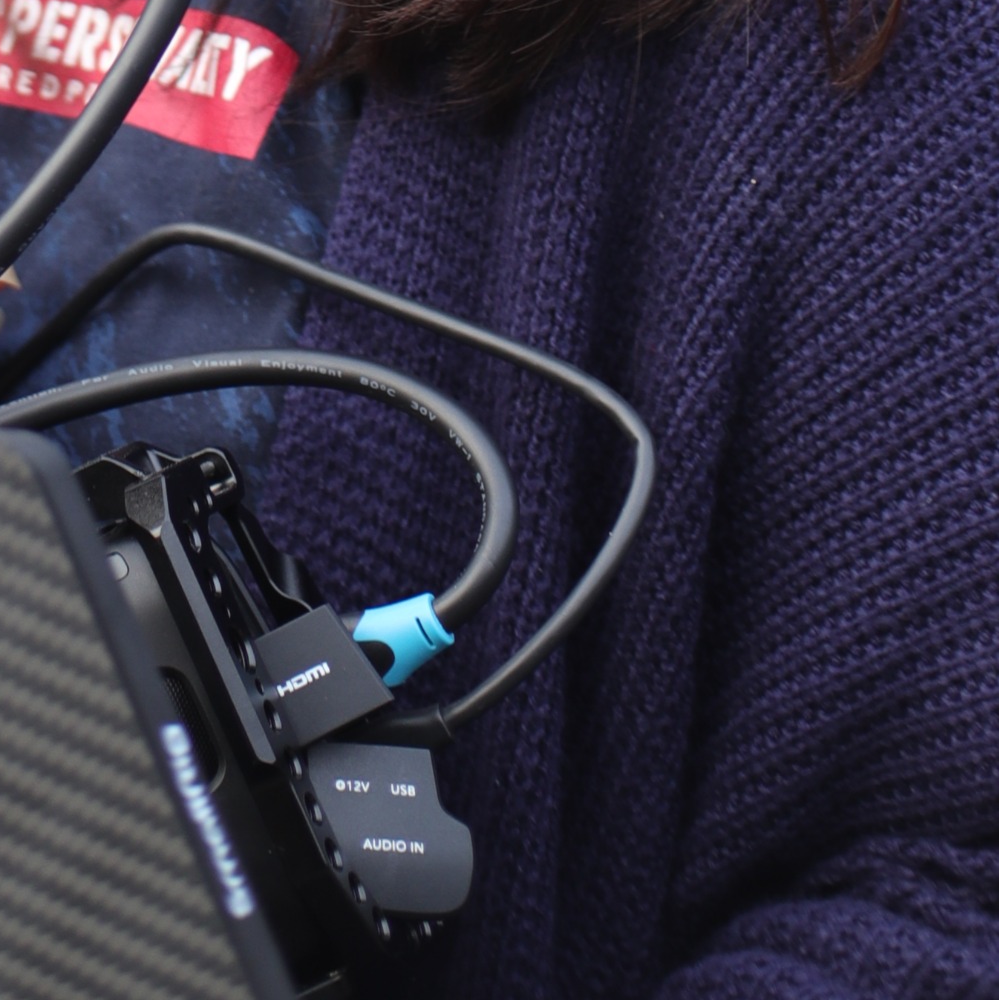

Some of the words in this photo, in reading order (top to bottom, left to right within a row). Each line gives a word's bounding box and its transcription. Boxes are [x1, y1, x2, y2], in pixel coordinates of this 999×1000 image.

[128, 363, 174, 376] Audio
[261, 358, 343, 379] Enjoyment
[411, 399, 437, 422] 30V
[276, 661, 331, 698] HDMI
[390, 784, 416, 797] USB
[362, 838, 407, 853] AUDIO
[409, 842, 425, 854] IN
